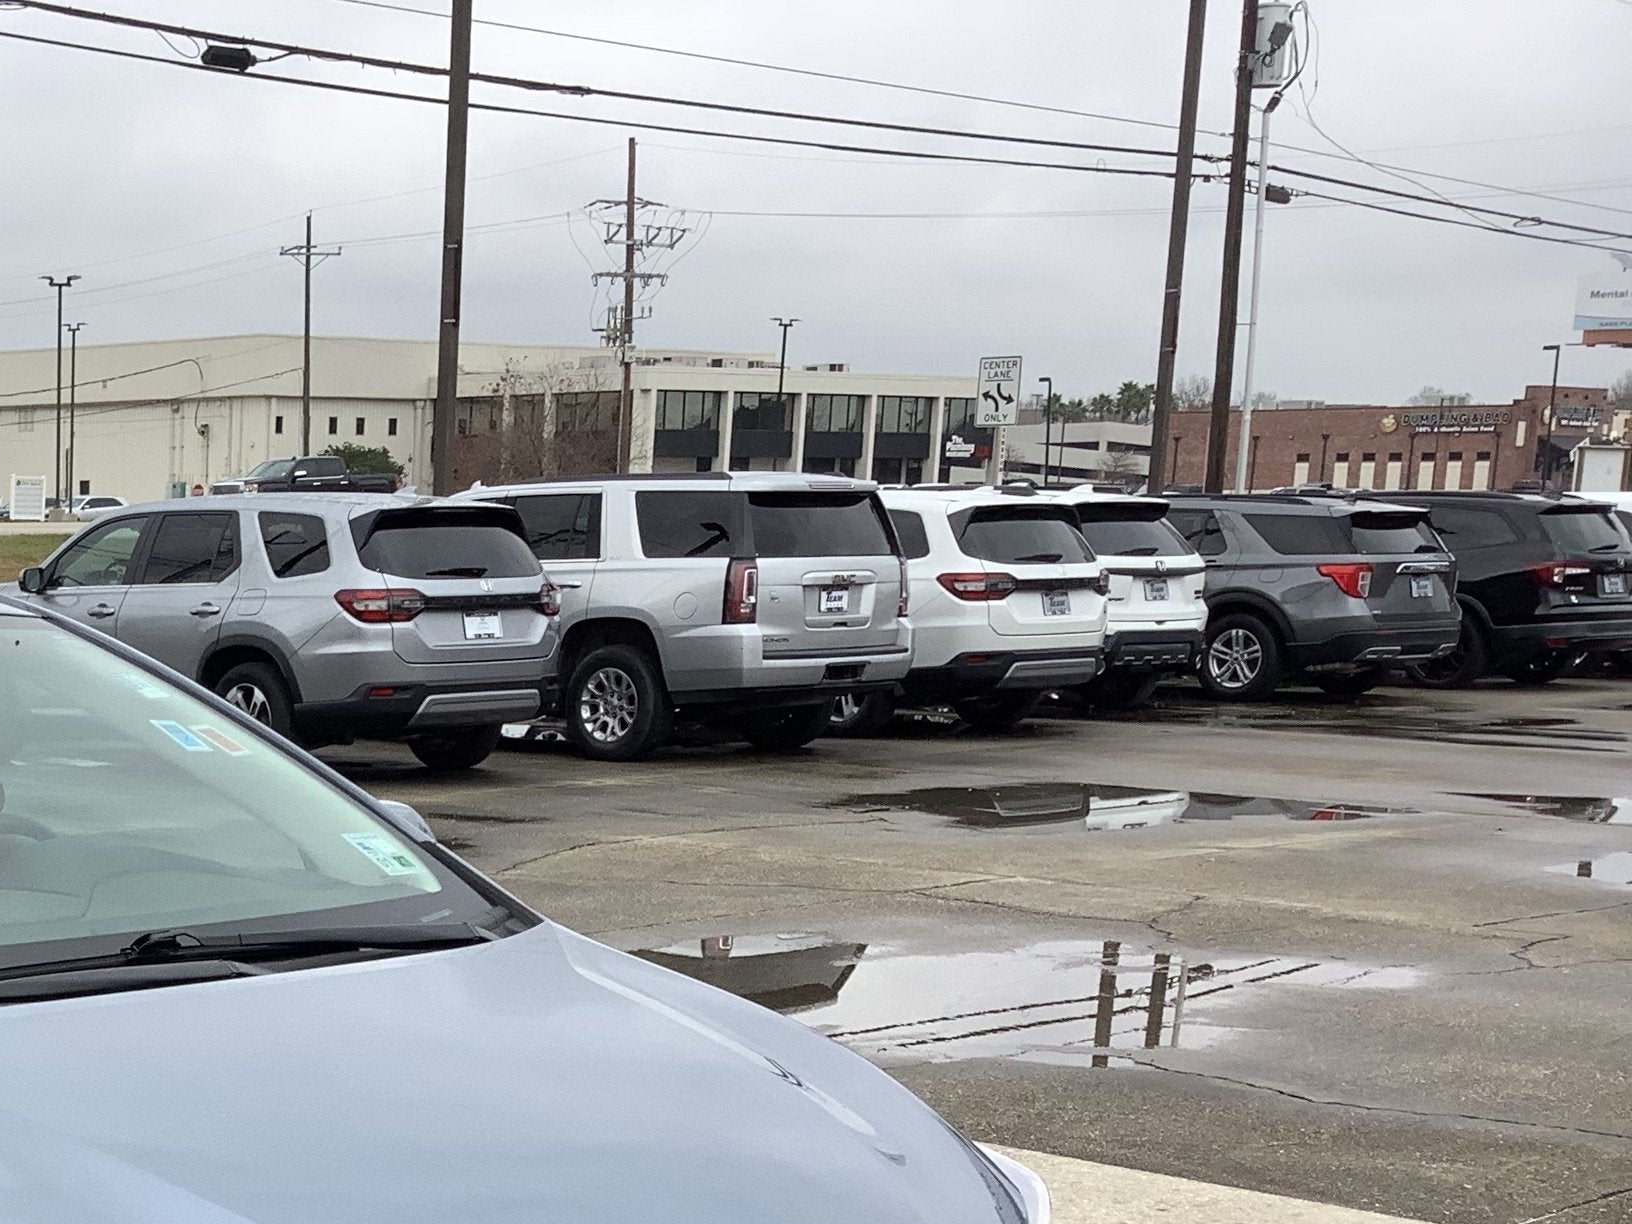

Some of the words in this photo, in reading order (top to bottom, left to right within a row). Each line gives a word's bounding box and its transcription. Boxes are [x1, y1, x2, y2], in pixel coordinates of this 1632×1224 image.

[1590, 289, 1629, 299] Mental
[983, 360, 1018, 370] CENTER
[987, 370, 1013, 379] LANE
[983, 413, 1009, 423] ONLY
[1471, 412, 1481, 424] &
